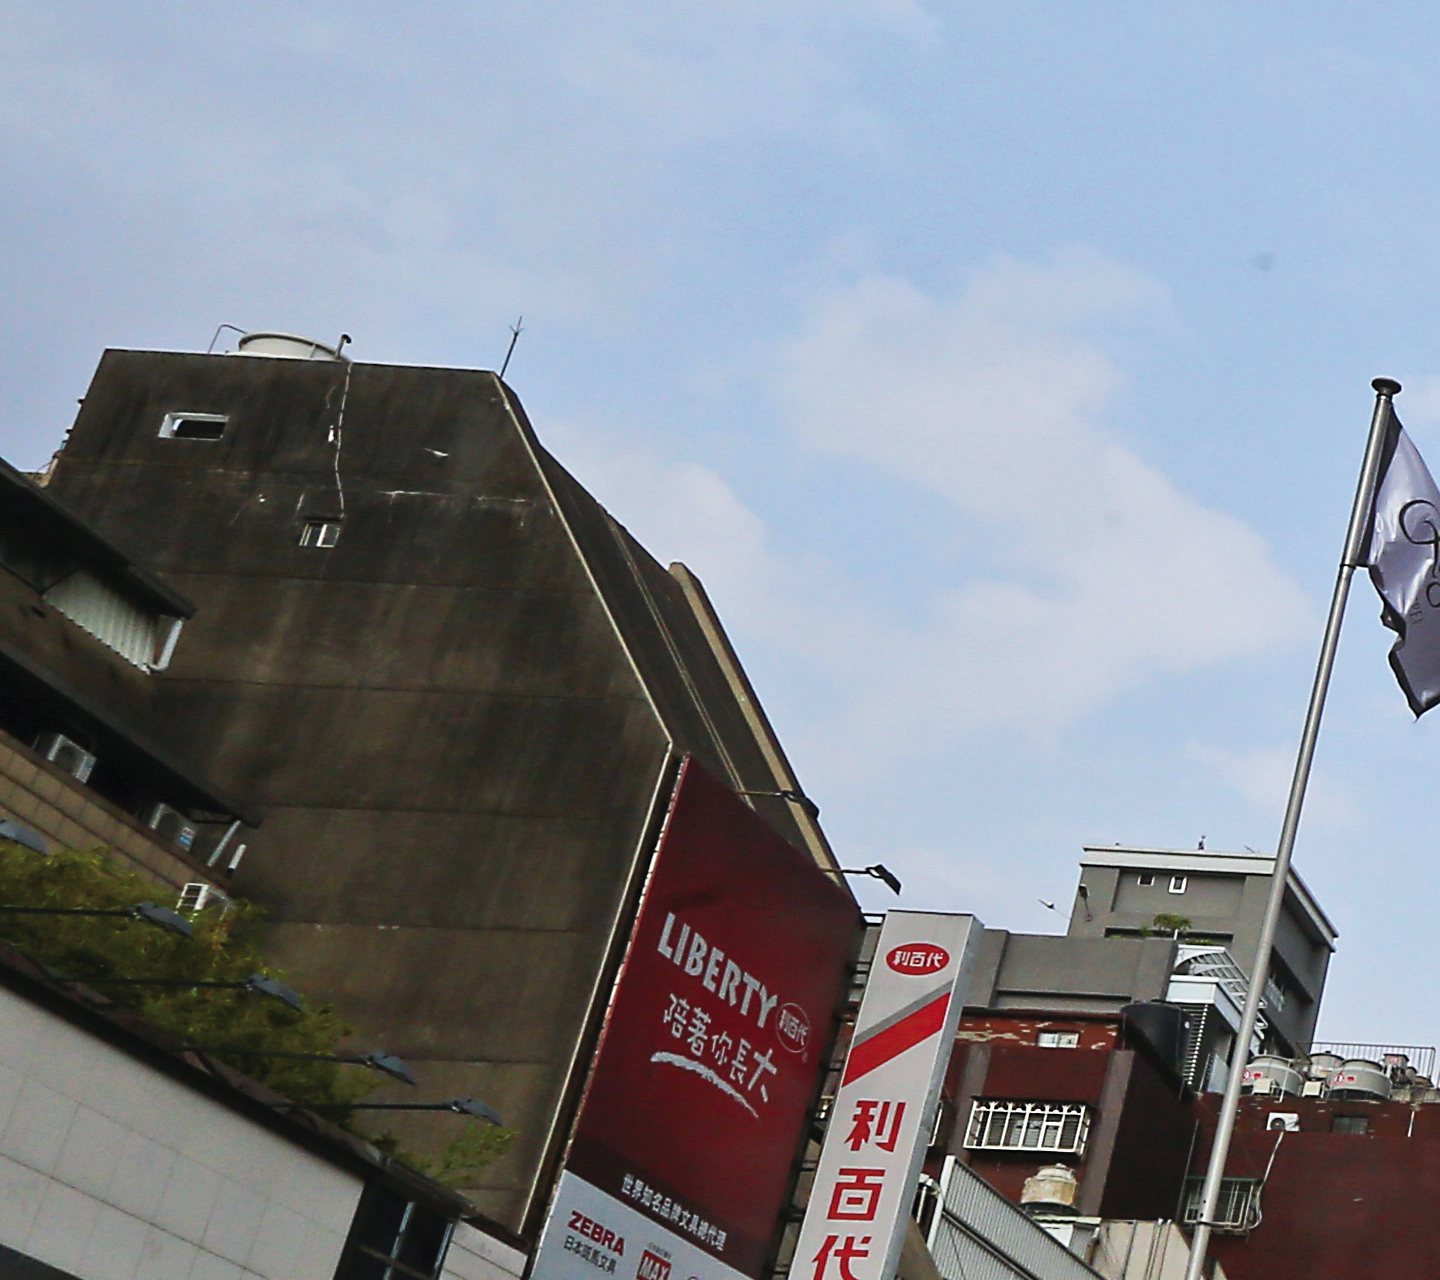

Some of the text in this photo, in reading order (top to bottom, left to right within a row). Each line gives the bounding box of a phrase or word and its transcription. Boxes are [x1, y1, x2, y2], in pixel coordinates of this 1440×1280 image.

[658, 912, 777, 1028] LIBERTY
[892, 950, 944, 968] 利百代
[663, 993, 777, 1103] 陪著你長大
[568, 1210, 625, 1256] ZEBRA
